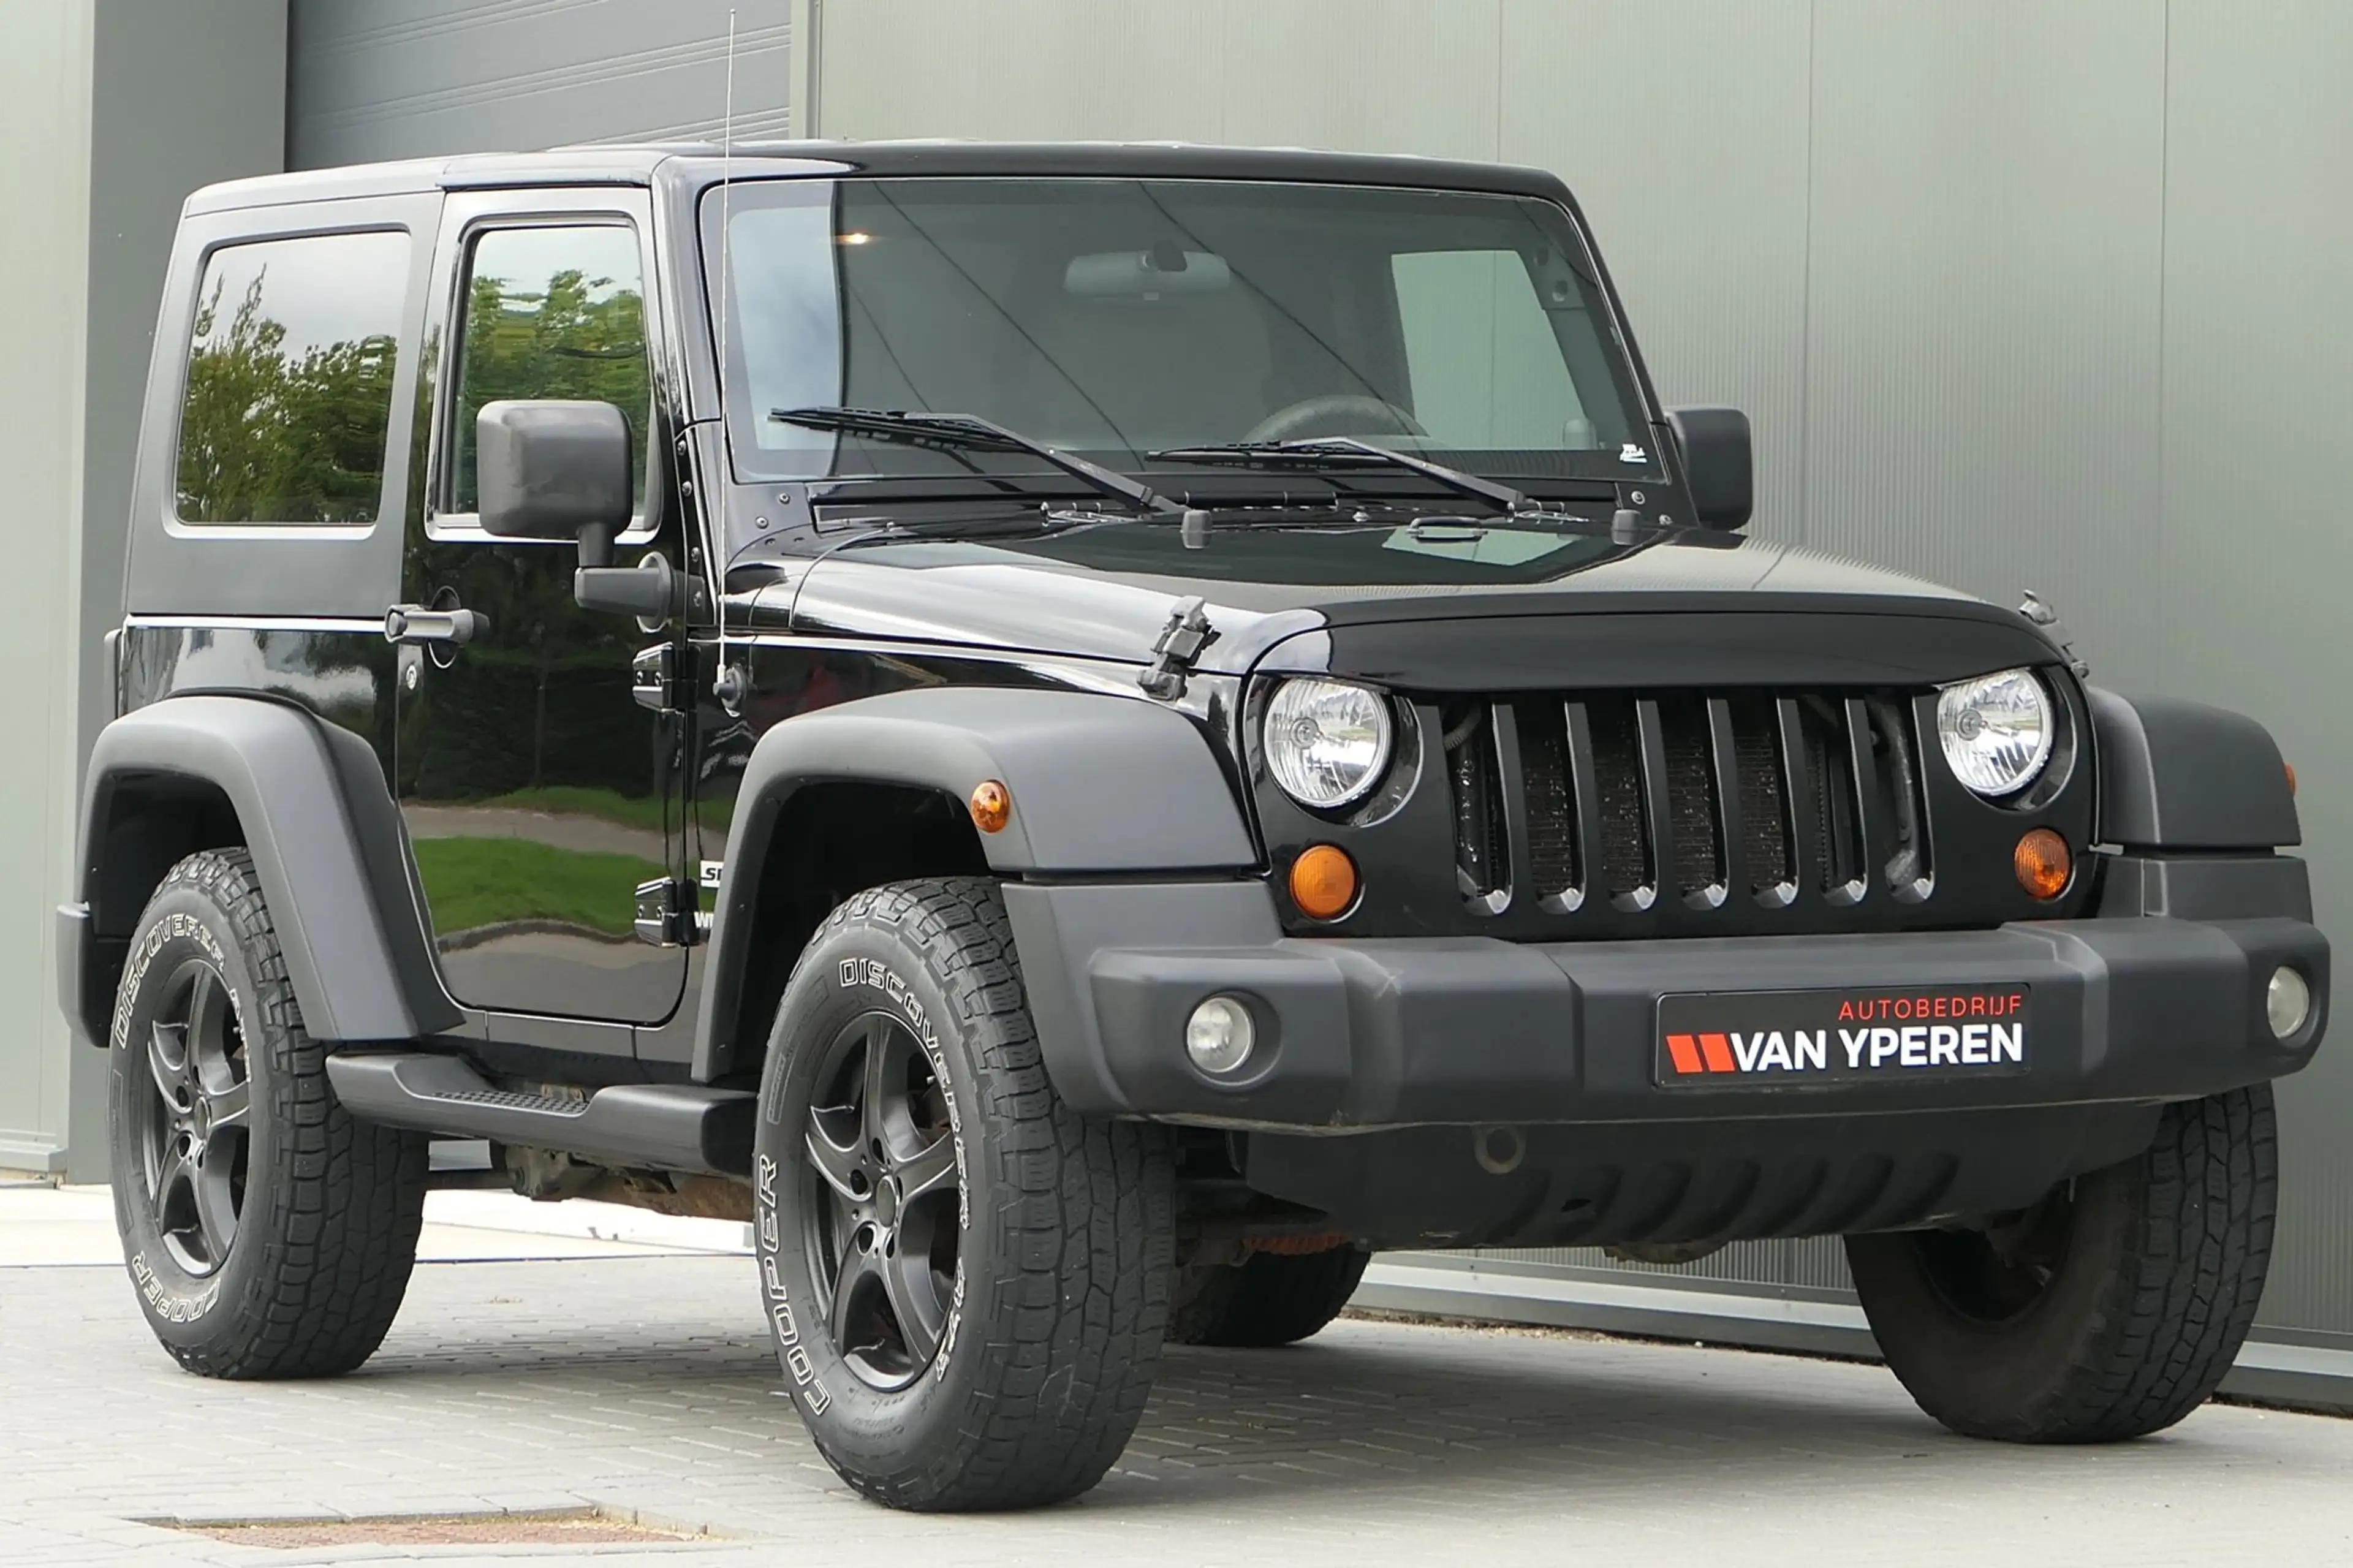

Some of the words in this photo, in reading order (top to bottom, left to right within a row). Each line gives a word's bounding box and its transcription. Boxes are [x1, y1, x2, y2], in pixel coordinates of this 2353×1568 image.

[115, 913, 224, 1050] DISCOVERER
[1838, 995, 2022, 1020] AUTOBEDRIJF
[1730, 1029, 1826, 1072] VAN
[1838, 1023, 2023, 1068] YPEREN
[132, 1250, 221, 1322] COOPER
[759, 1154, 832, 1416] COOPER
